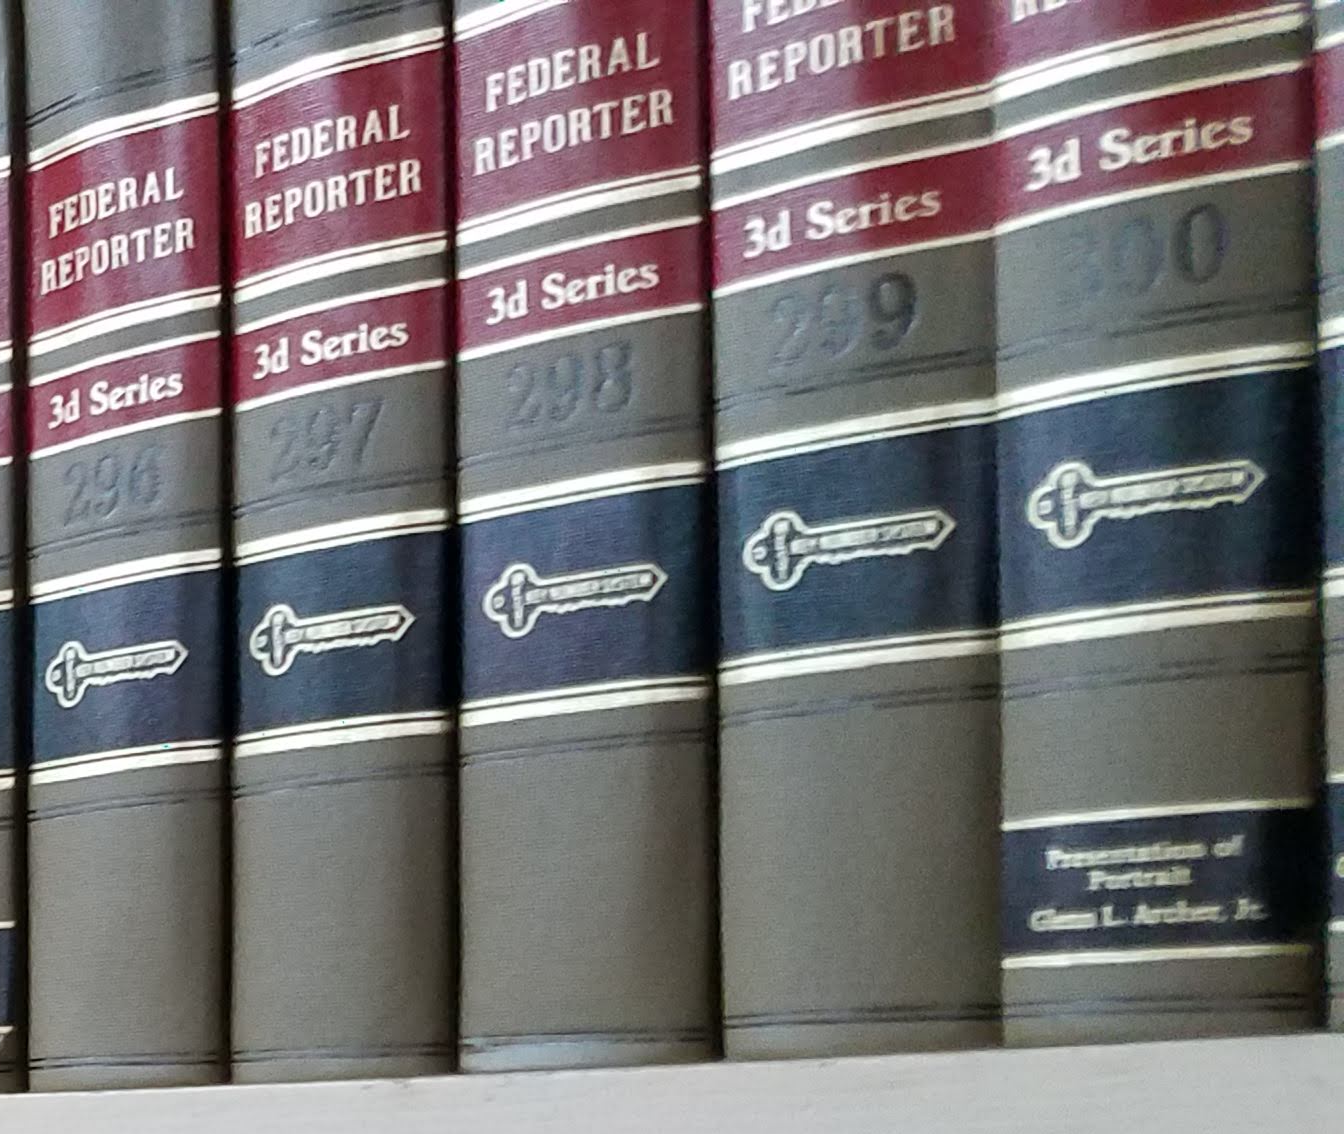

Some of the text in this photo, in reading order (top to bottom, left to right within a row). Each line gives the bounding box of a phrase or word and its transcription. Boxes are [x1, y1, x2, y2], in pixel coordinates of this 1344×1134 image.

[485, 31, 661, 114] FEDERAL
[727, 8, 957, 100] REPORTER
[253, 104, 410, 180] FEDERAL
[472, 89, 674, 176] REPORTER
[1025, 114, 1254, 191] 3d Series
[48, 166, 184, 238] FEDERAL
[243, 158, 422, 239] REPORTER
[742, 189, 942, 260] 3d Series
[39, 217, 195, 296] REPORTER
[485, 263, 660, 326] 3d Series
[252, 319, 409, 381] 3d Series
[502, 340, 634, 428] 298
[48, 373, 183, 429] 3d Series
[266, 398, 386, 480] 297
[63, 446, 163, 528] 296
